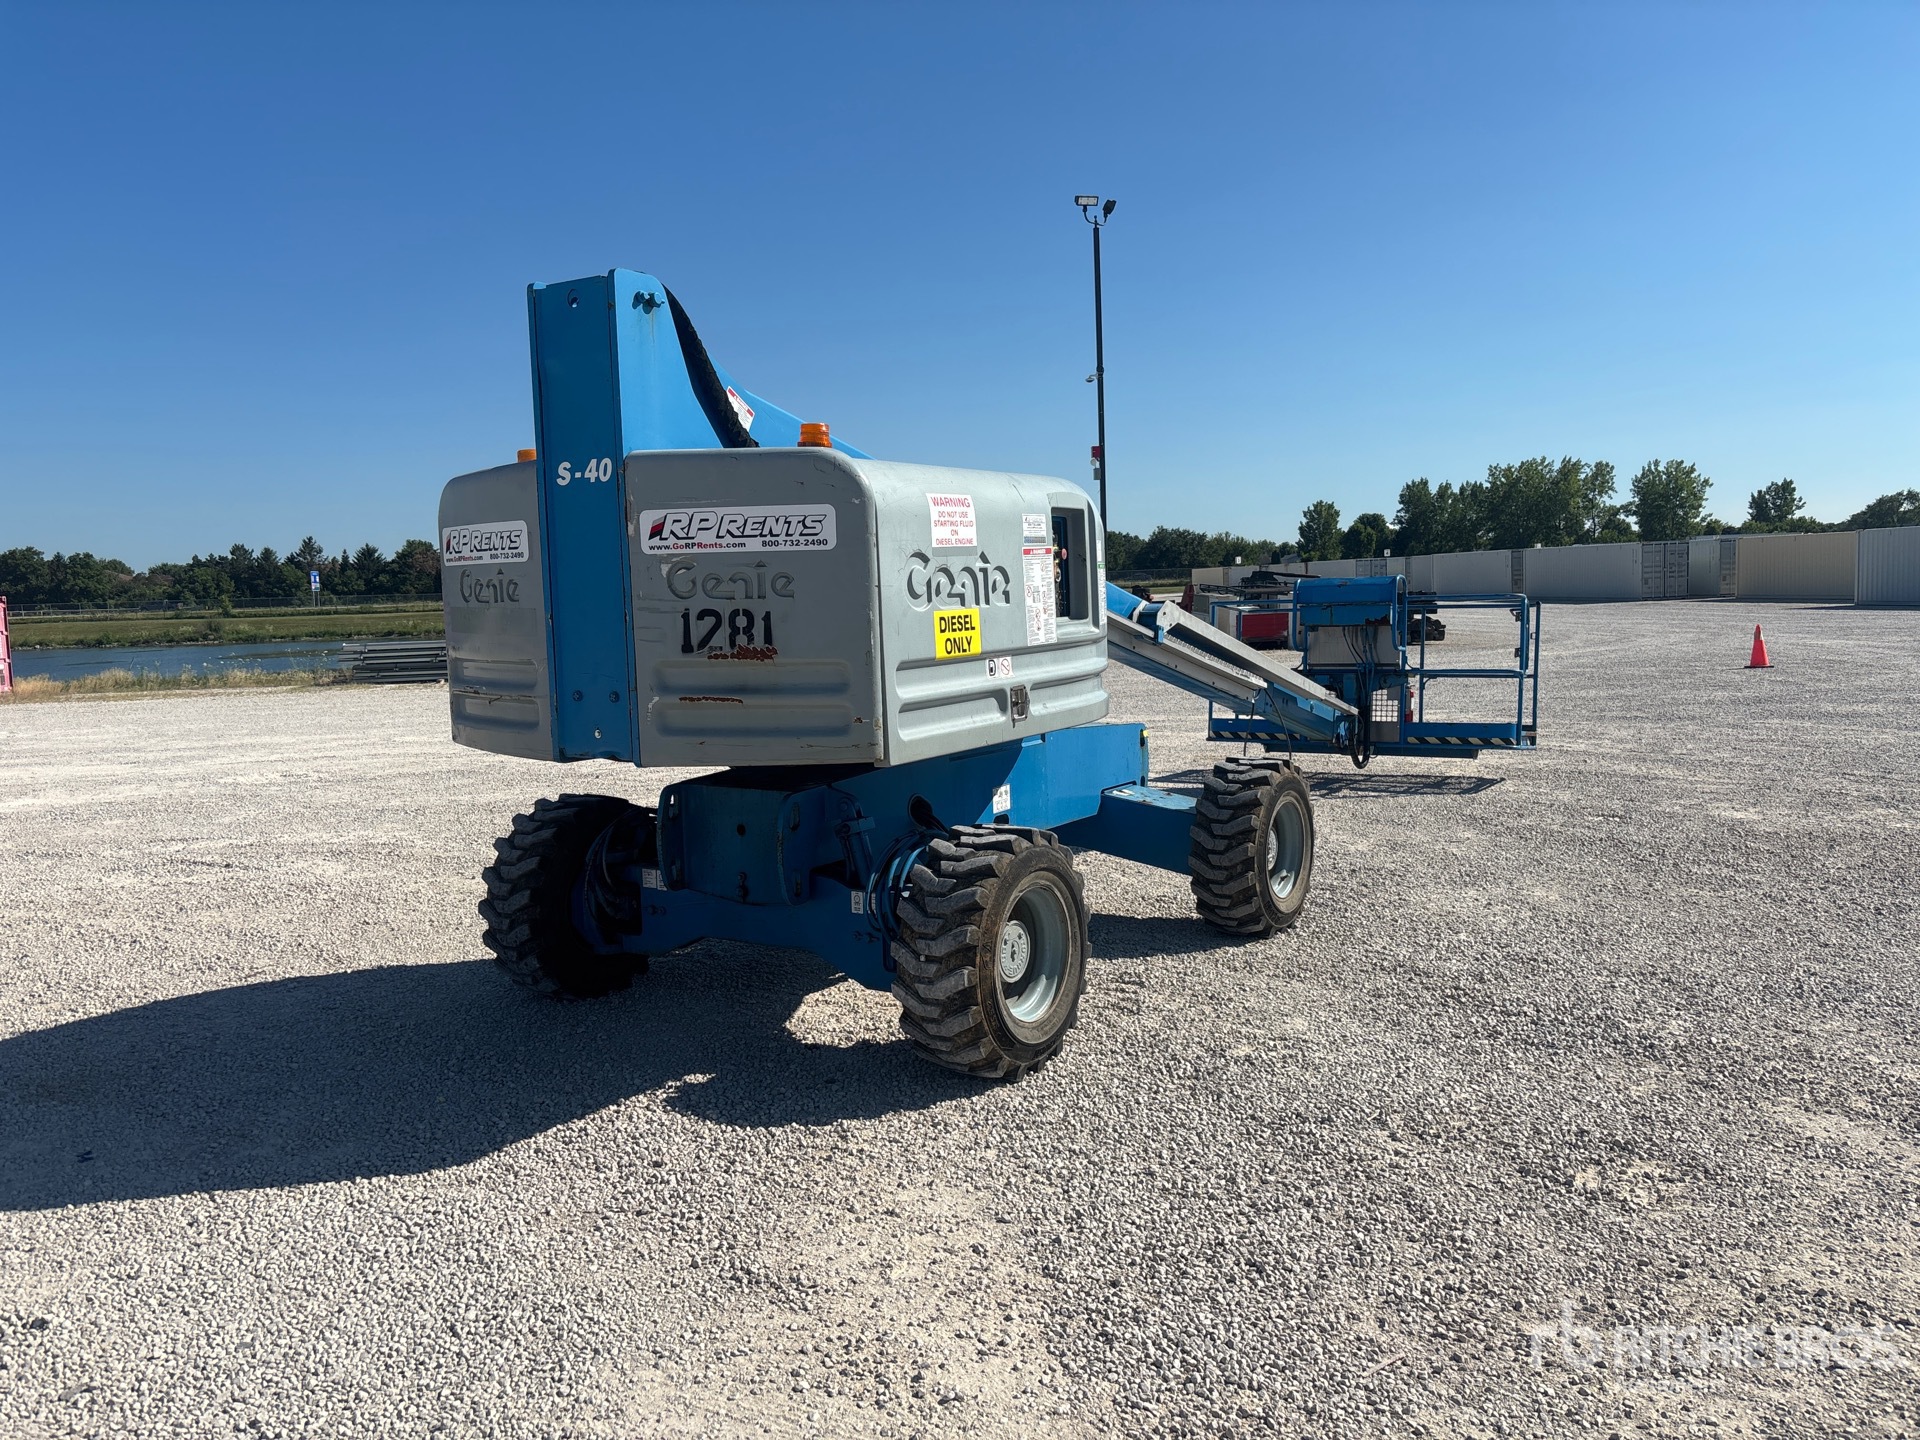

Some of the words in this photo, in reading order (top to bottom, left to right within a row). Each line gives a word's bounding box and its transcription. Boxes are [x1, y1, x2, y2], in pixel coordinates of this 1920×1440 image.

[556, 457, 612, 486] S-40
[930, 496, 971, 508] WARNING
[490, 551, 524, 560] 800-732-2490
[648, 541, 746, 551] www.GoRPRents.com
[761, 538, 828, 548] 800-732-2490
[460, 568, 519, 603] Genie
[666, 559, 795, 600] Genie
[904, 551, 1010, 611] Genie
[681, 608, 773, 653] 1281
[939, 614, 975, 633] DIESEL
[945, 636, 972, 655] ONLY
